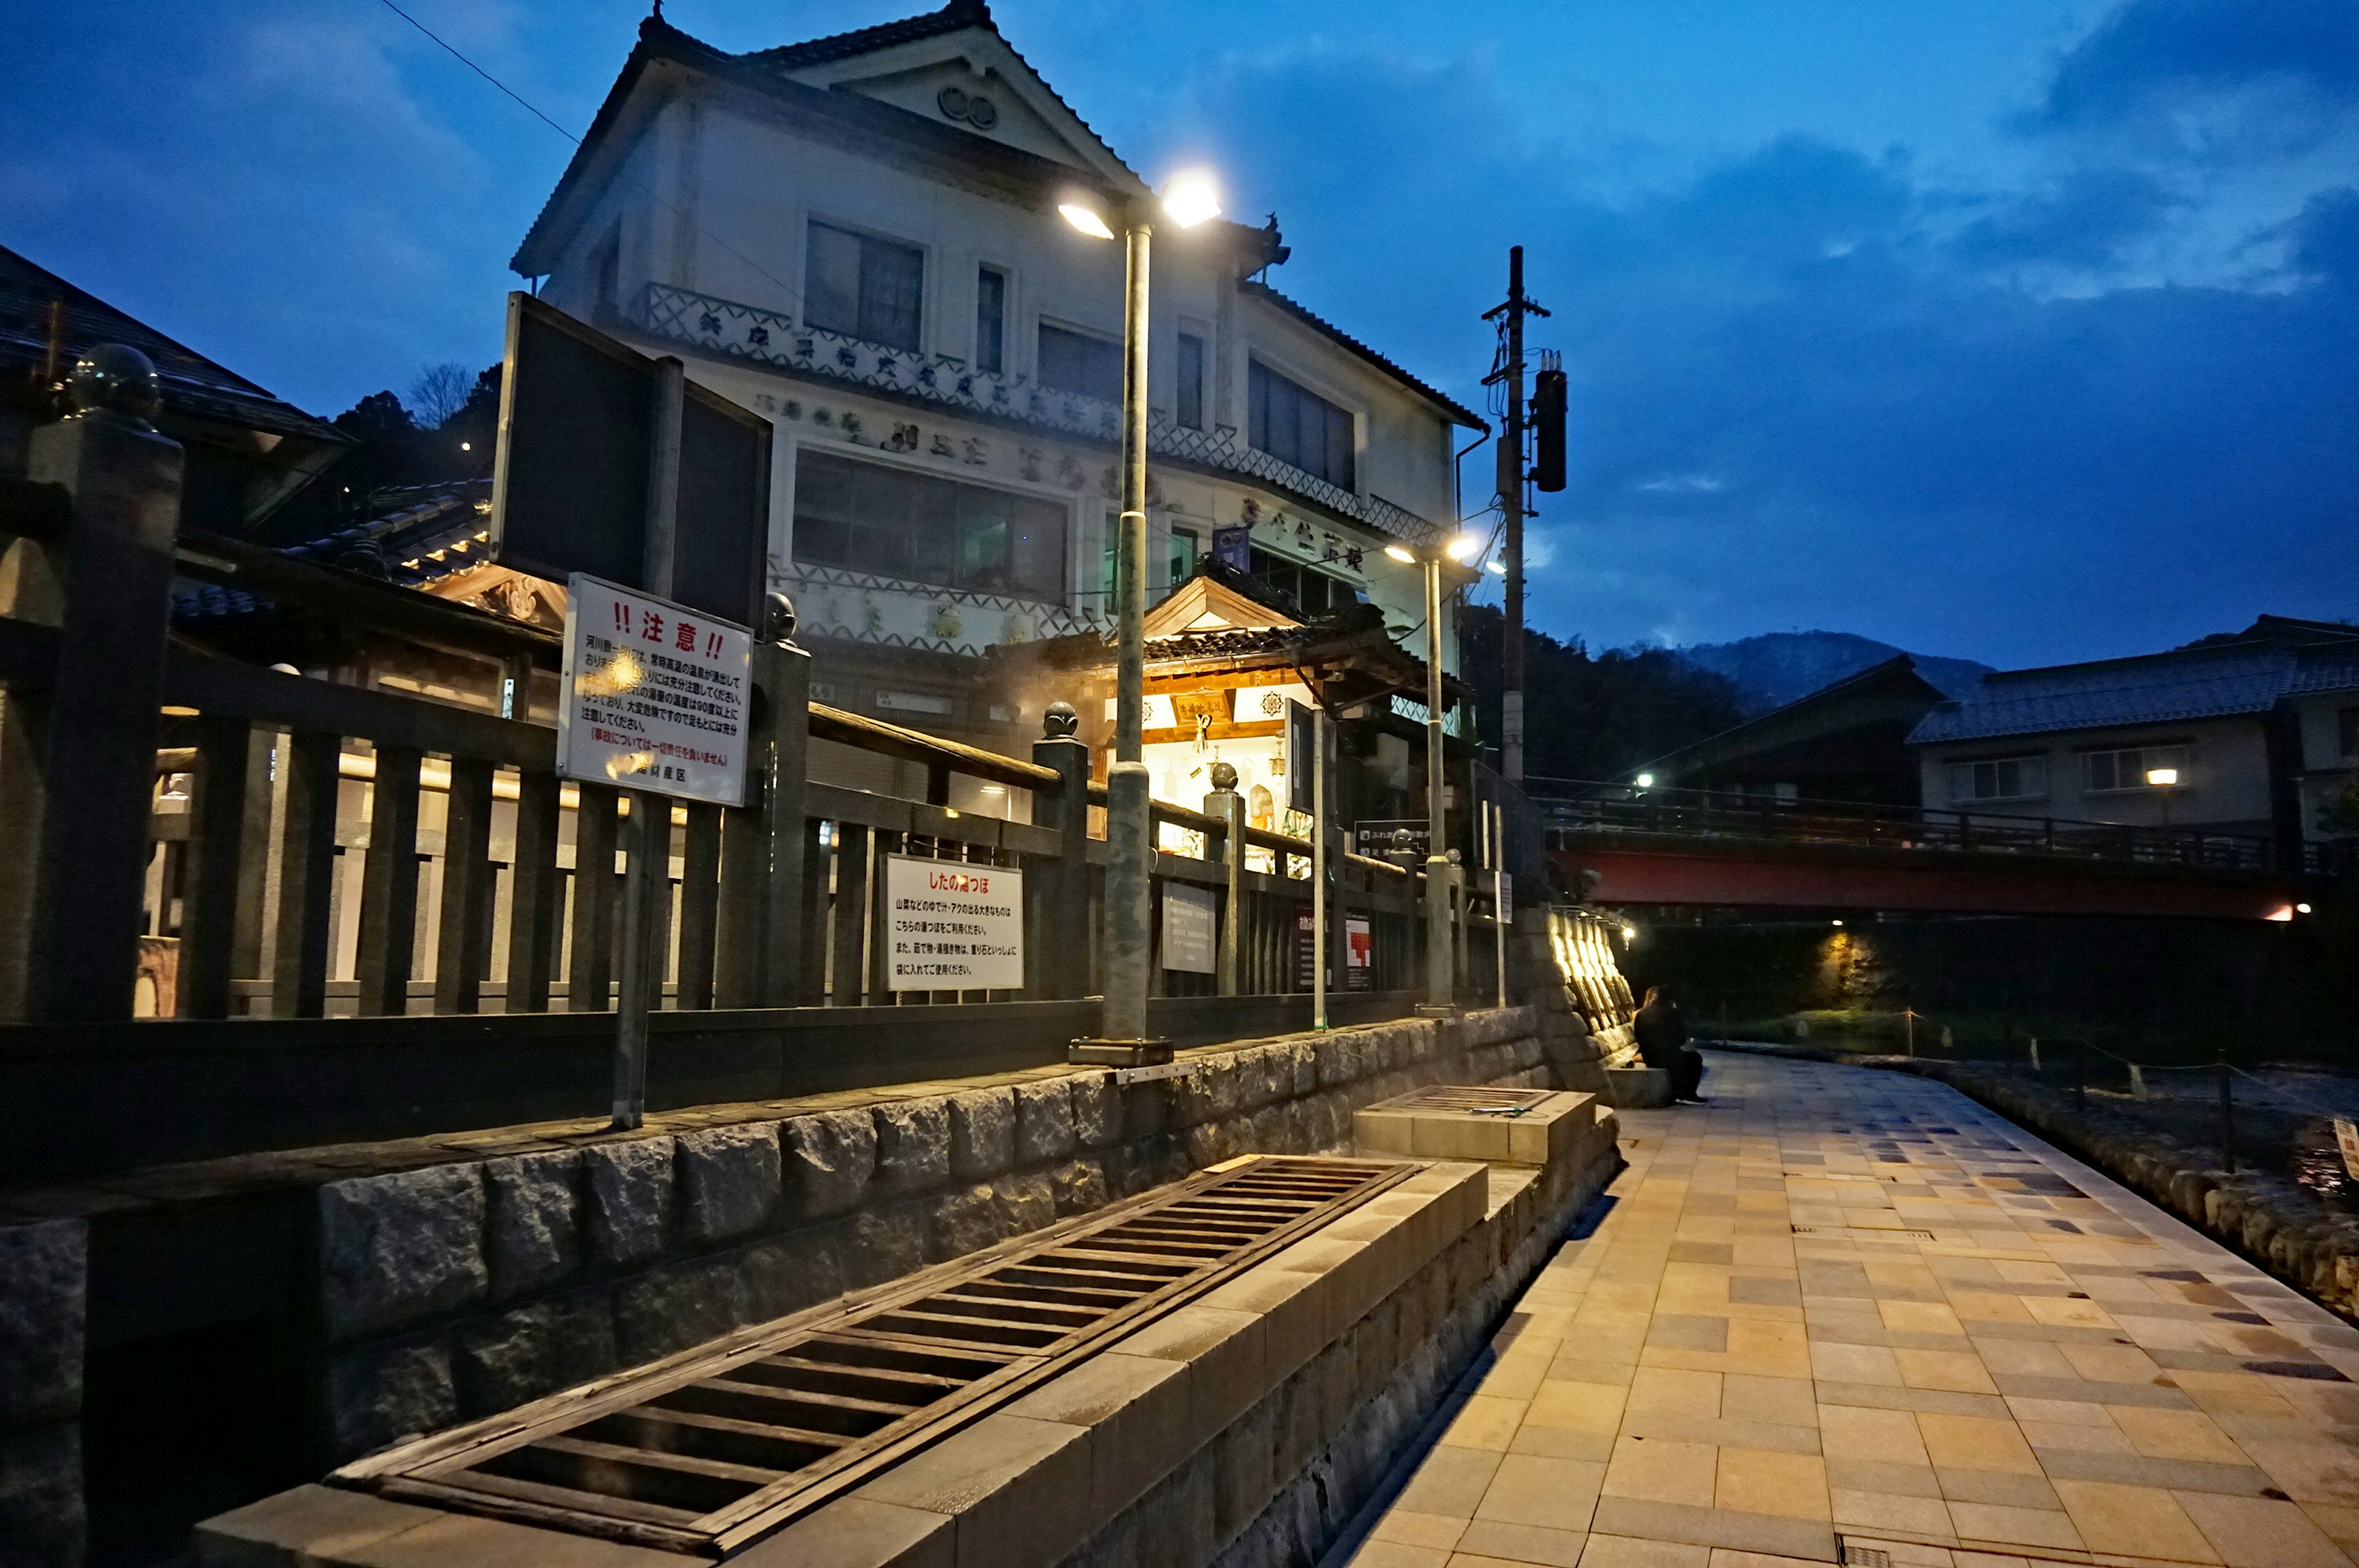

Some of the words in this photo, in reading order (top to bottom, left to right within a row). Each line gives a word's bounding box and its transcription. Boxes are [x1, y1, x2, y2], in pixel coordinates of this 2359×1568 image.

[581, 706, 646, 733] 注意してください。
[896, 920, 987, 936] こちらの湯つぼをご利用ください。
[896, 964, 972, 975] 袋に入れてご使用ください。
